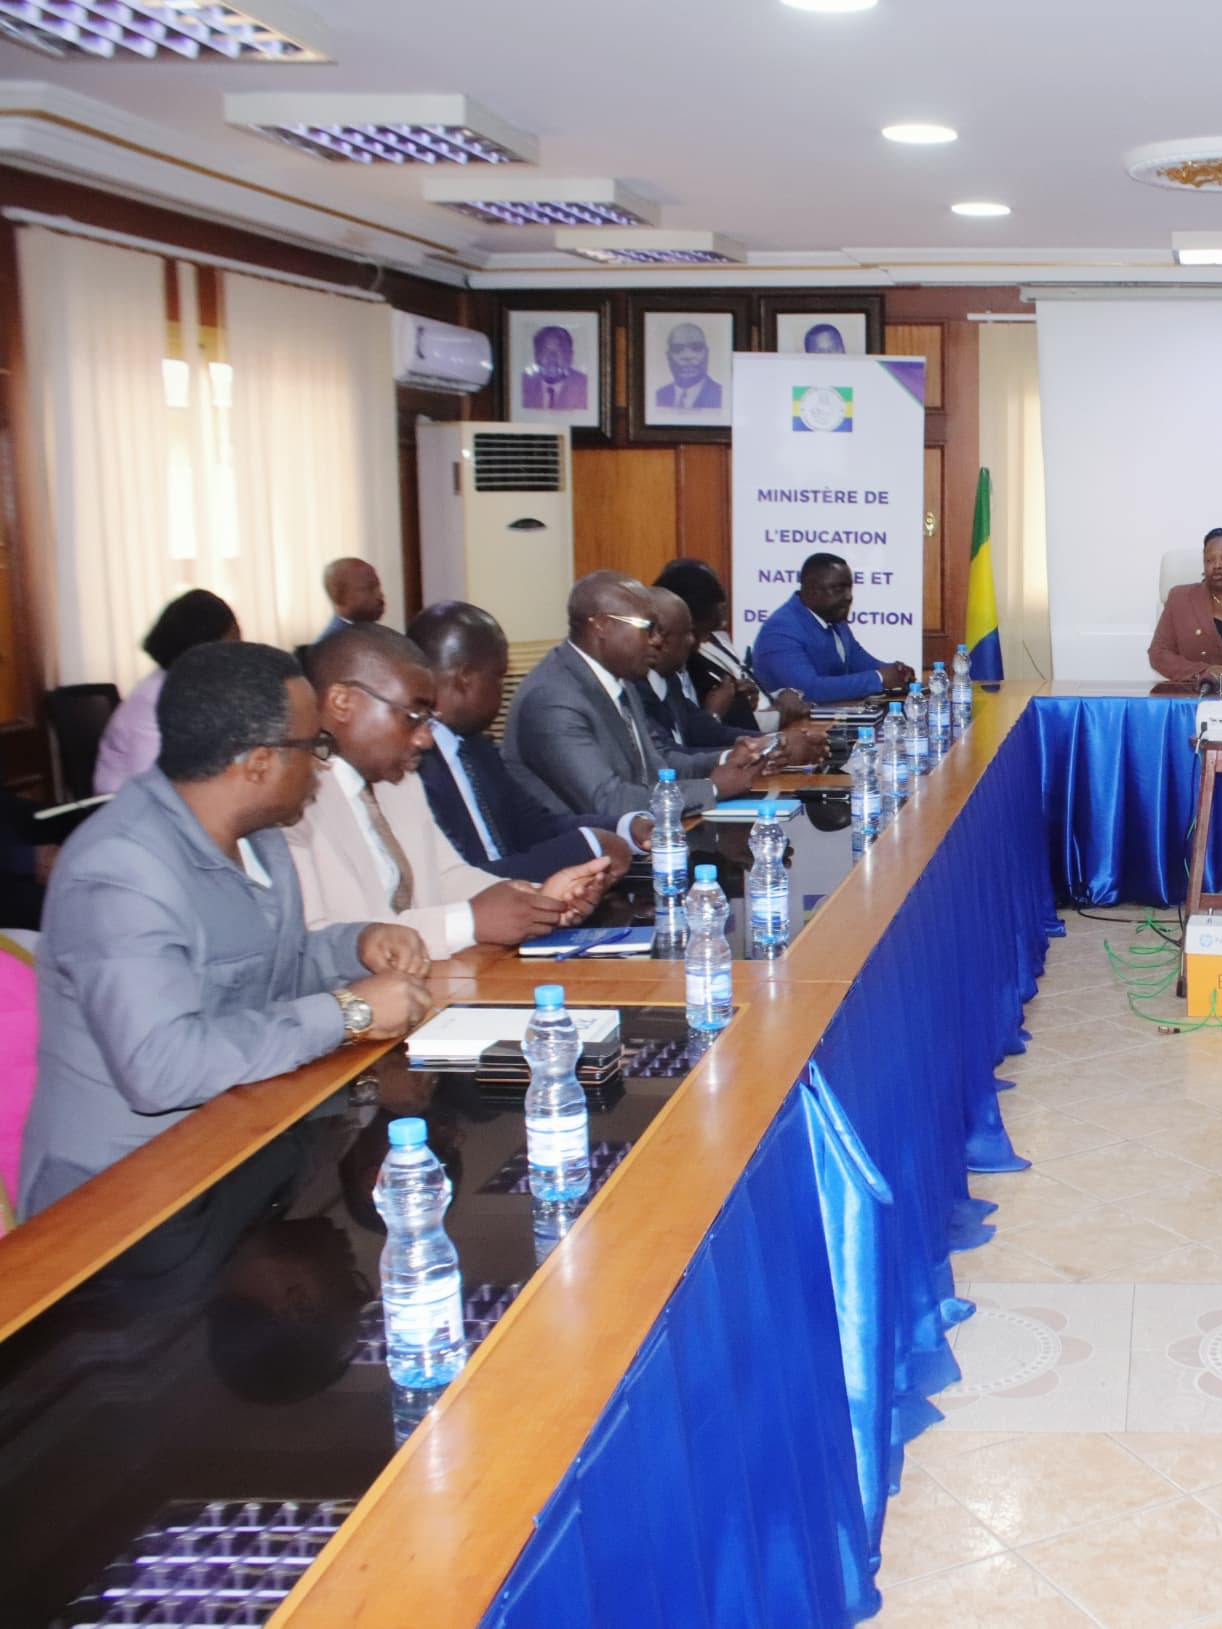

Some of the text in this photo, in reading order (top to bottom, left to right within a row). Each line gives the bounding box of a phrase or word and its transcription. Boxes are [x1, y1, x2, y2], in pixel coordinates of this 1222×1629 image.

[758, 487, 889, 504] MINISTÈRE DE
[765, 529, 887, 544] L'EDUCATION
[758, 569, 894, 585] NATIE ET
[744, 609, 768, 623] DE
